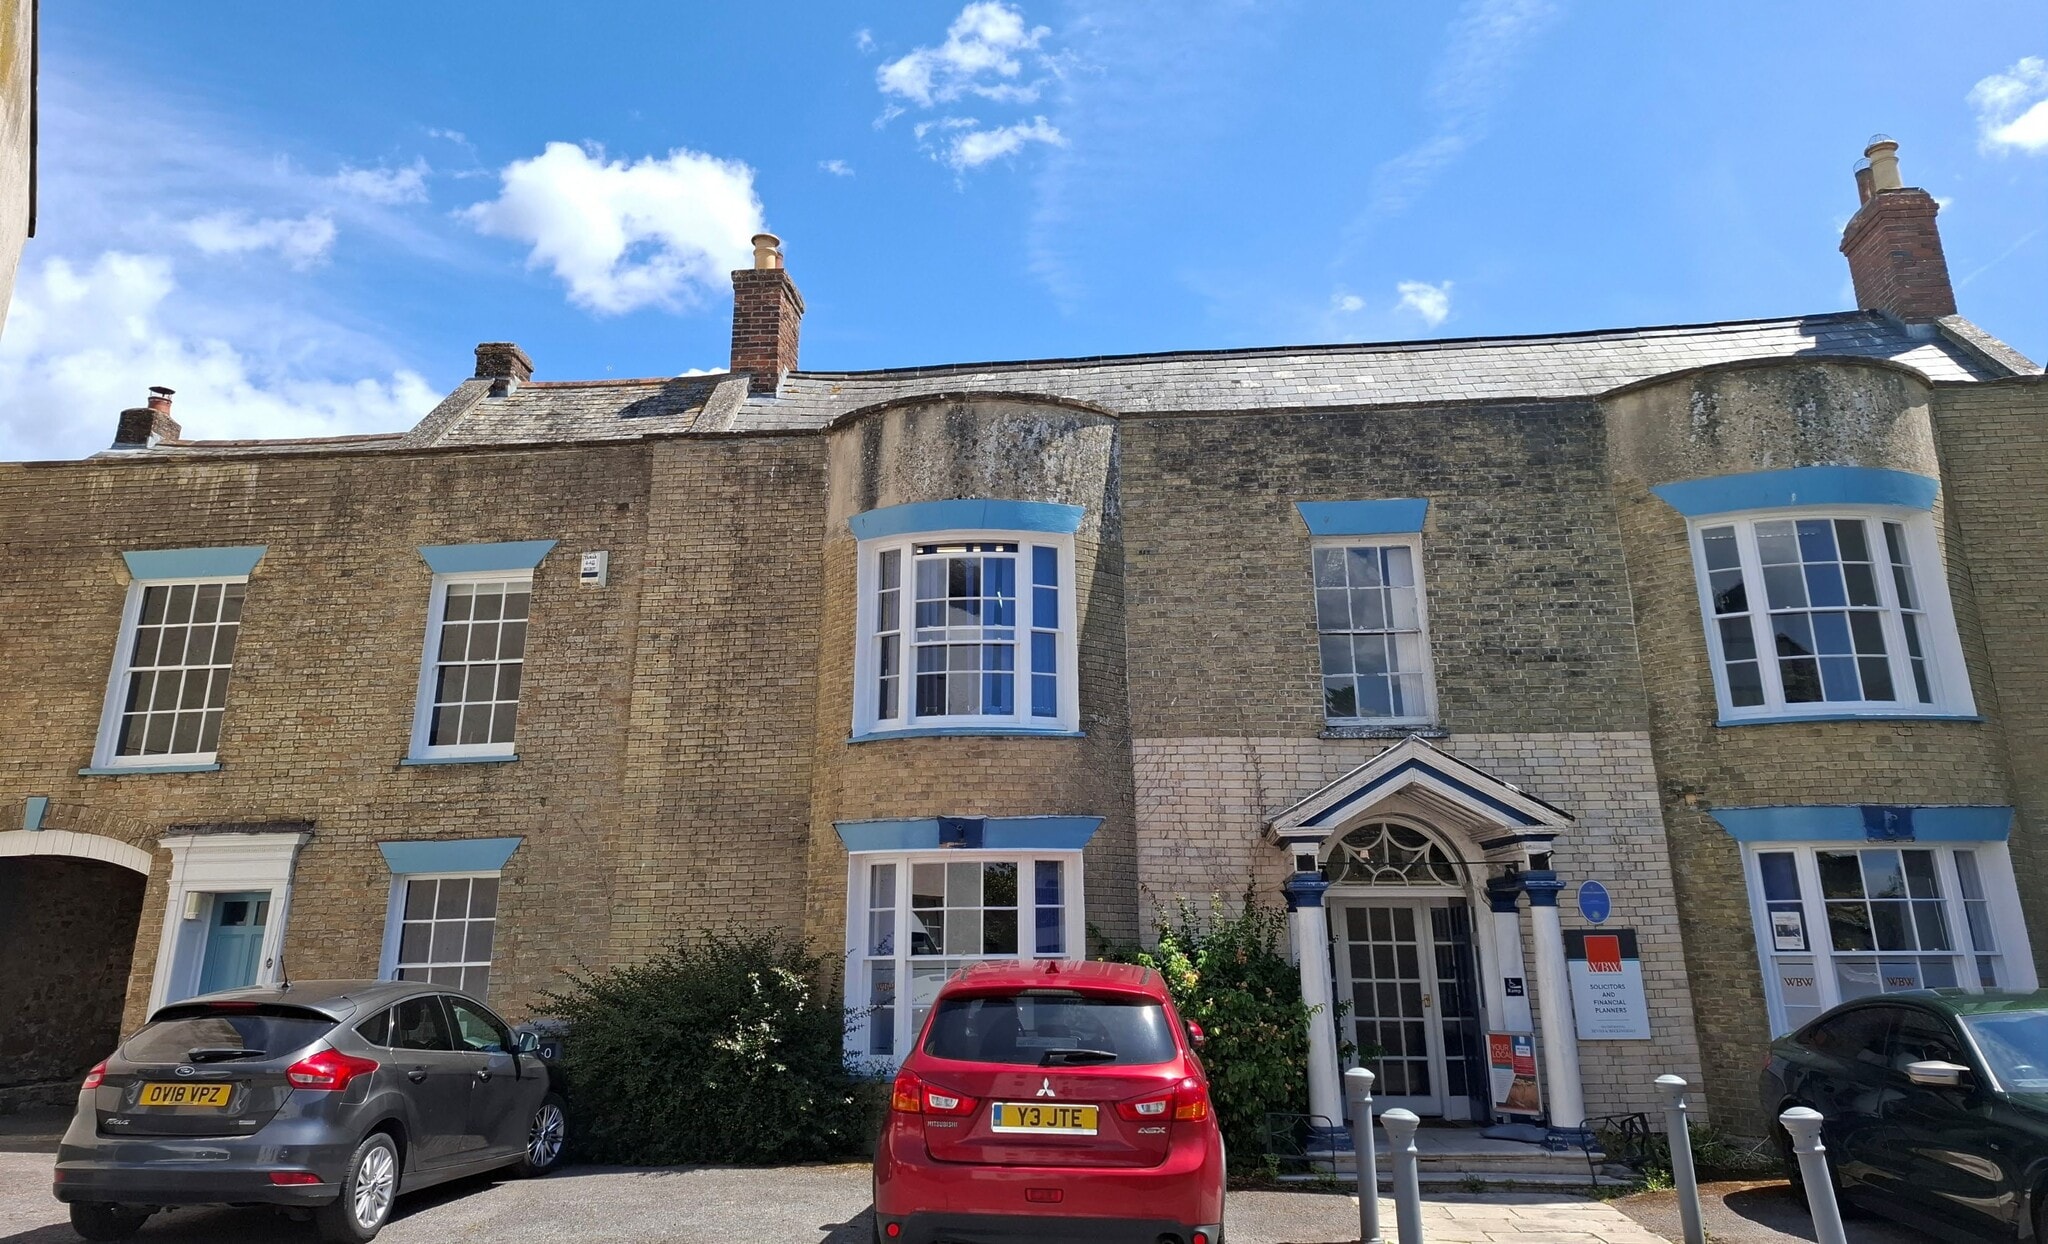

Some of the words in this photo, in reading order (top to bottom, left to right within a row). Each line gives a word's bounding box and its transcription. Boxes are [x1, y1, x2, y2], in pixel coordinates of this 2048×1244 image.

[1587, 961, 1623, 973] WBW
[1783, 977, 1814, 987] WBW
[1886, 977, 1915, 987] WBW
[1491, 1043, 1509, 1051] YOUR
[1492, 1051, 1512, 1059] LOCAL
[150, 1086, 186, 1101] OV18
[190, 1087, 221, 1103] VPZ
[1017, 1107, 1041, 1126] Y3
[1046, 1109, 1083, 1128] JTE
[927, 1120, 958, 1128] MITSUBISHI
[1137, 1126, 1166, 1134] ASX
